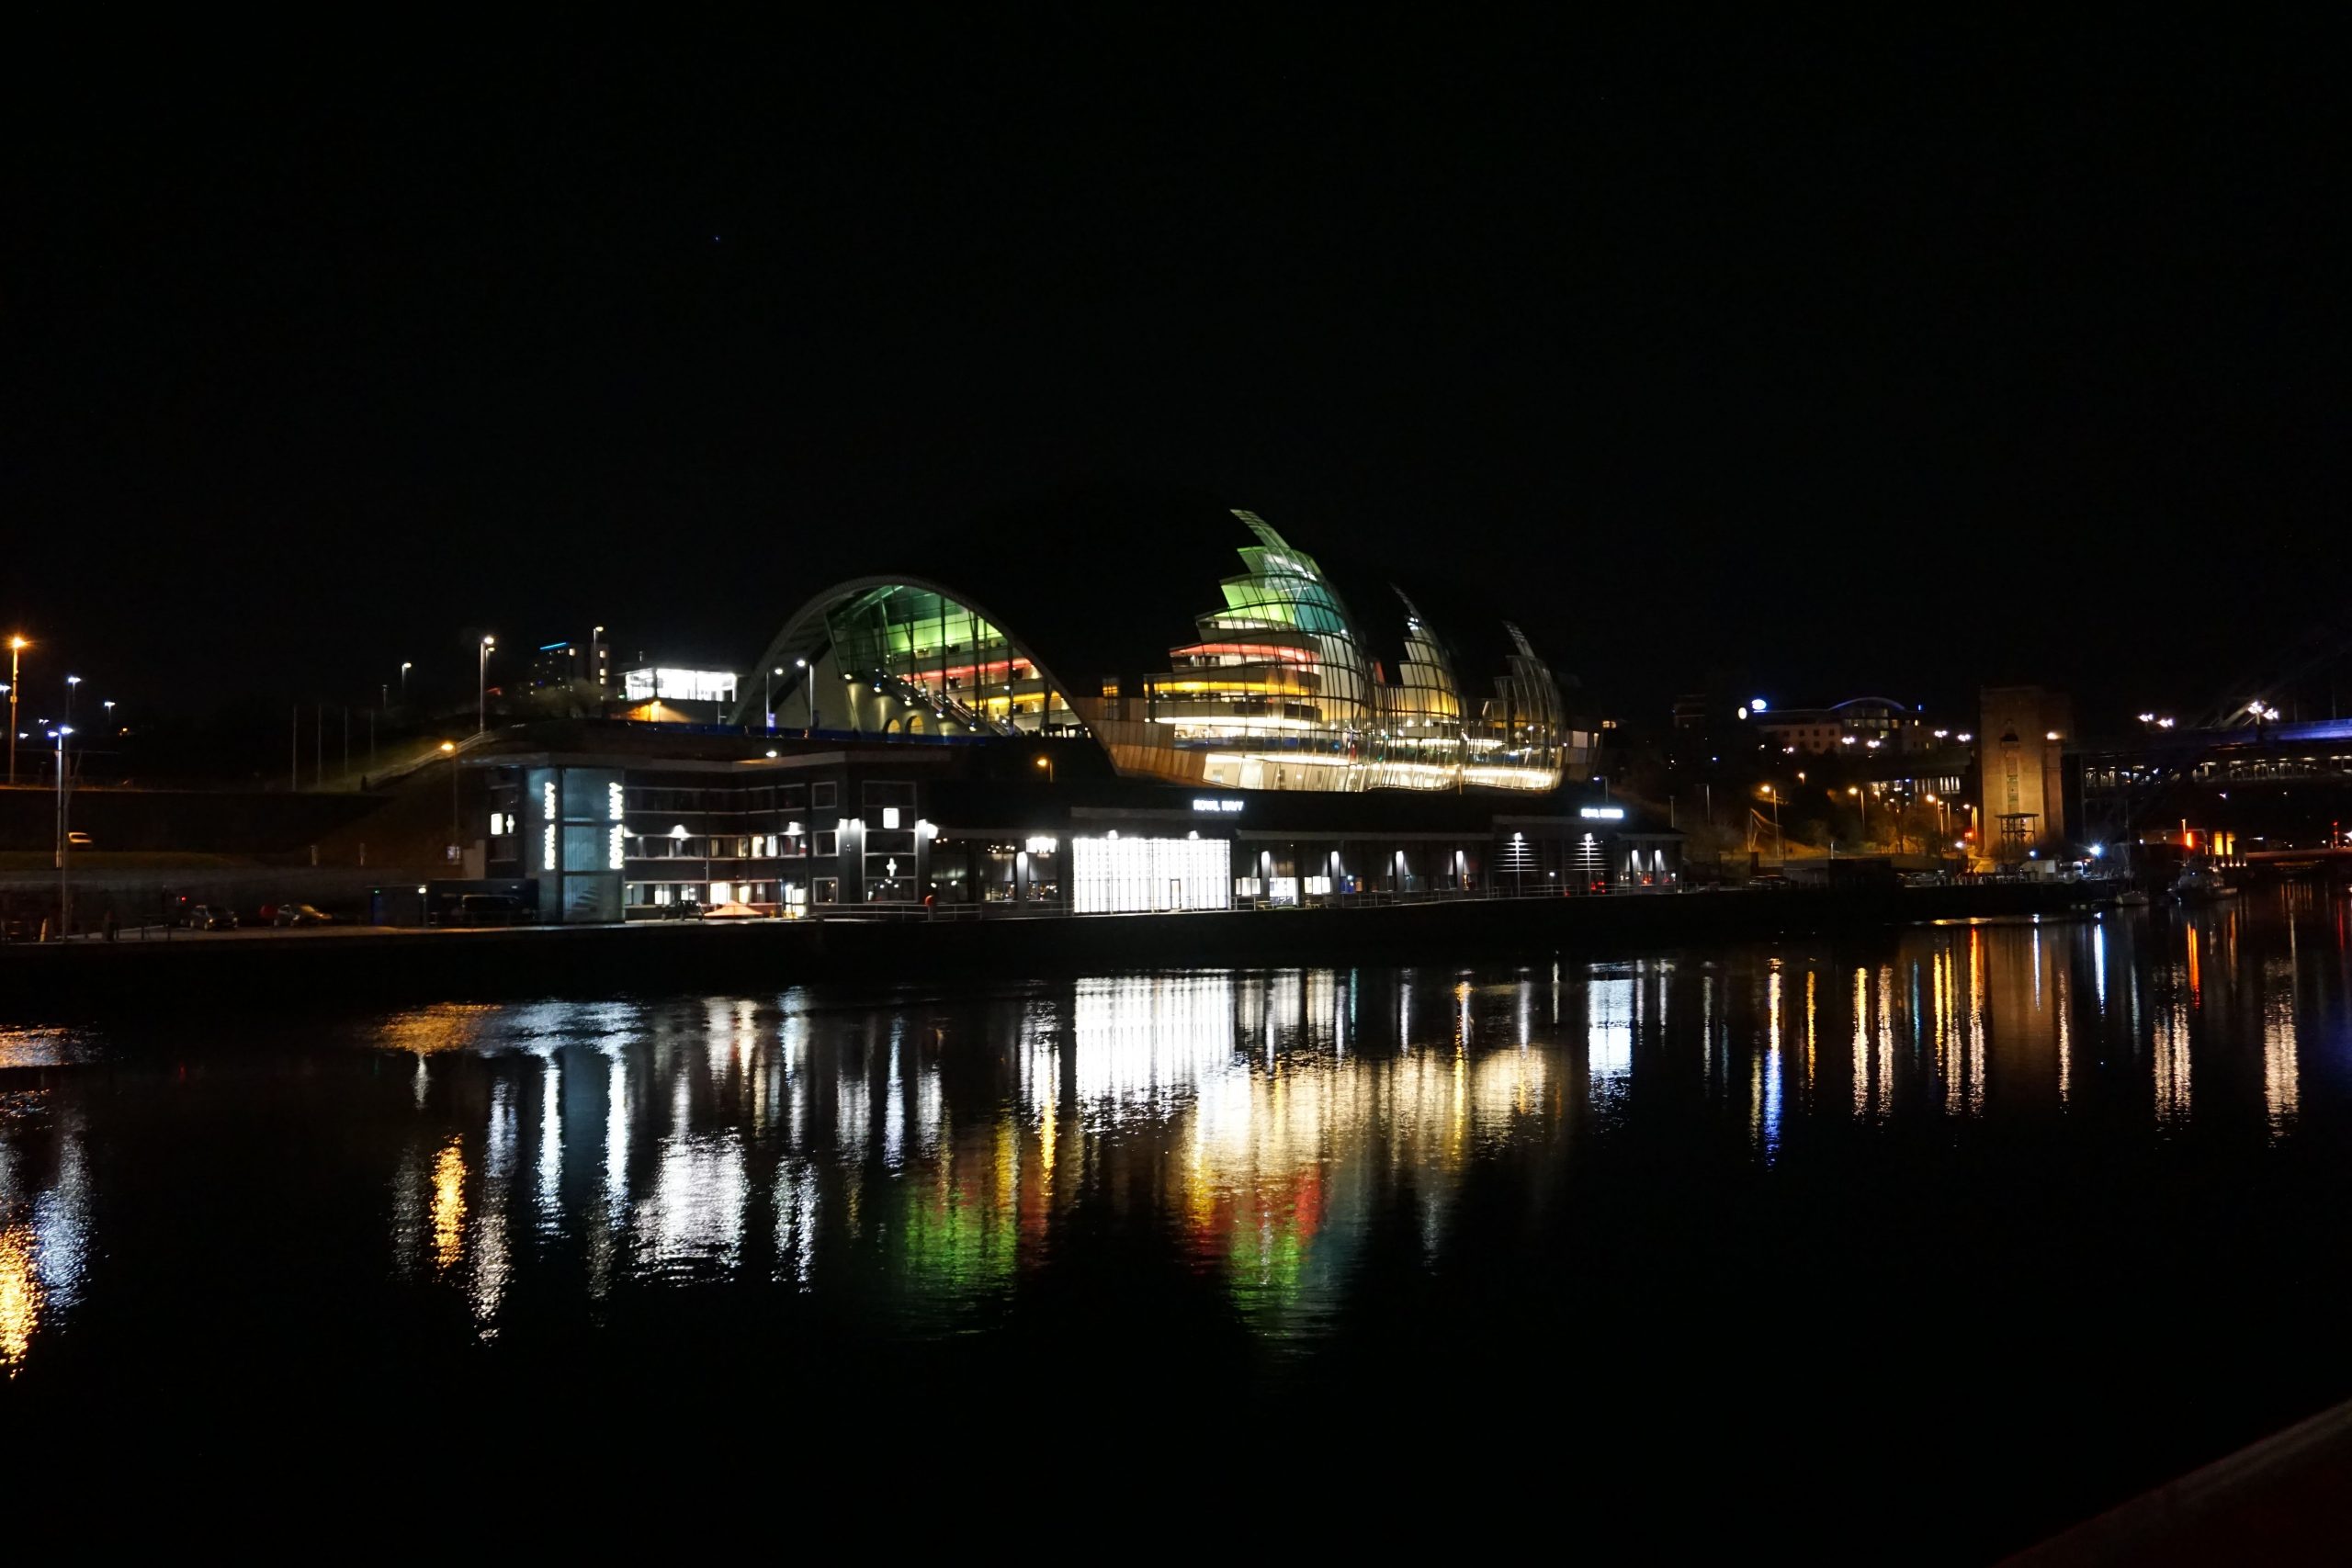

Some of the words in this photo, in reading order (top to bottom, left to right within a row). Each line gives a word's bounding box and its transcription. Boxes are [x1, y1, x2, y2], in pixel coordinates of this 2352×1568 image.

[608, 782, 623, 820] NAVY
[1193, 799, 1221, 812] ROYAL
[1221, 801, 1244, 812] NAVY
[609, 823, 624, 870] ROYAL
